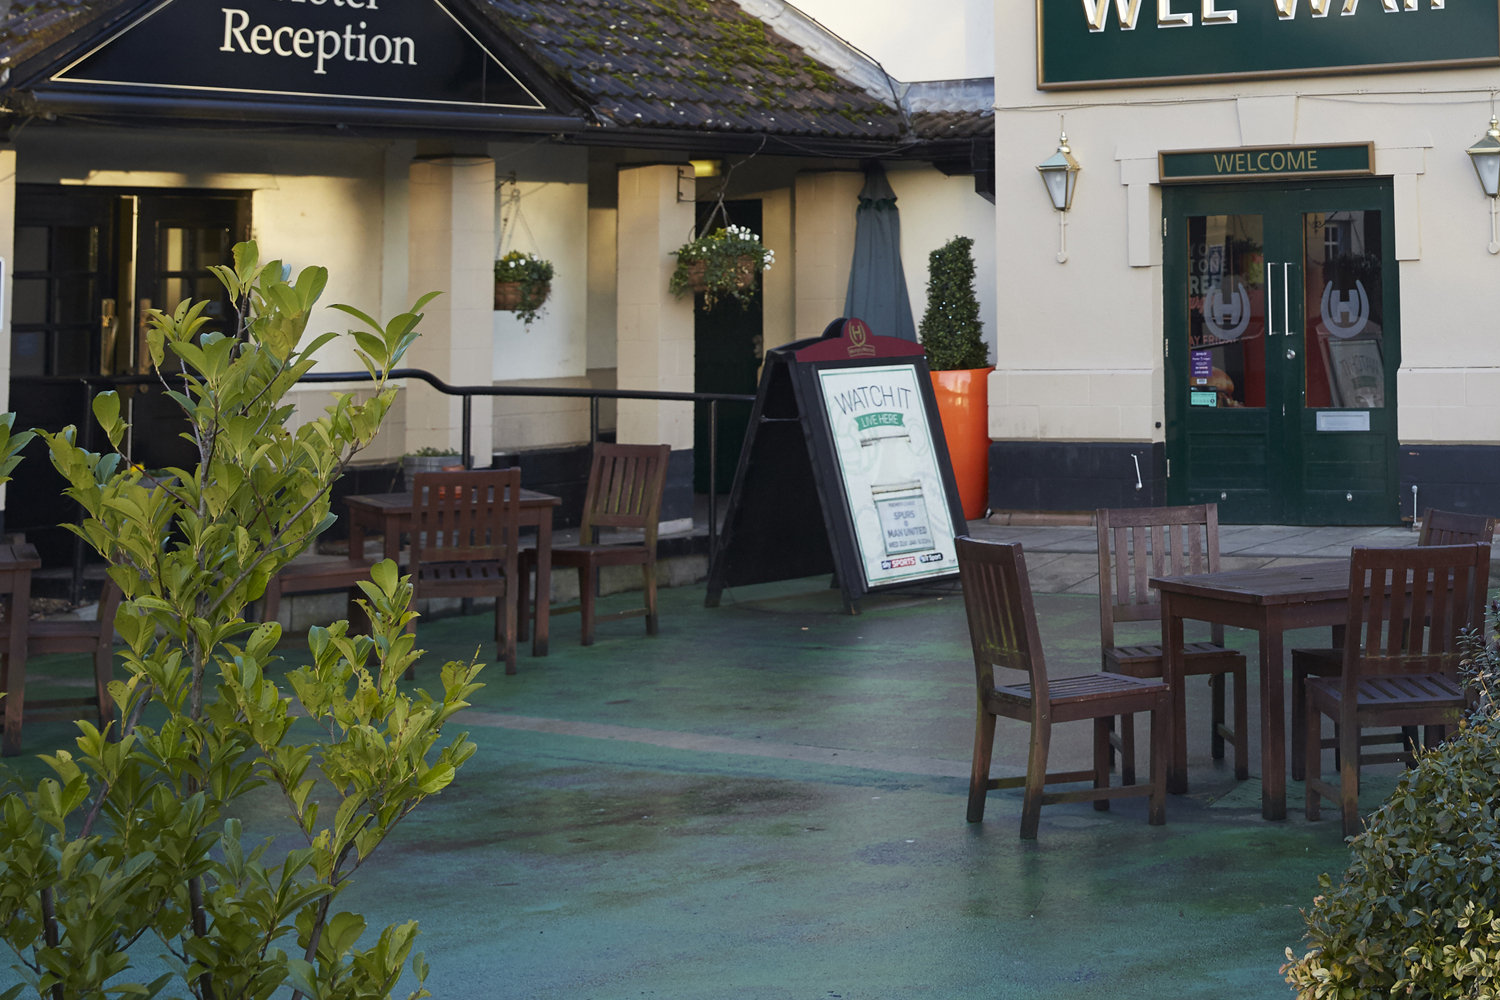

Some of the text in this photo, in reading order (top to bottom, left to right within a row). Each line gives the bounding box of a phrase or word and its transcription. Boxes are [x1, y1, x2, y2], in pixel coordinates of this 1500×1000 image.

[219, 8, 418, 74] Reception
[1213, 150, 1318, 173] WELCOME
[834, 385, 911, 415] WATCH IT
[860, 413, 899, 428] LIVE HERE
[904, 526, 927, 537] UNITED
